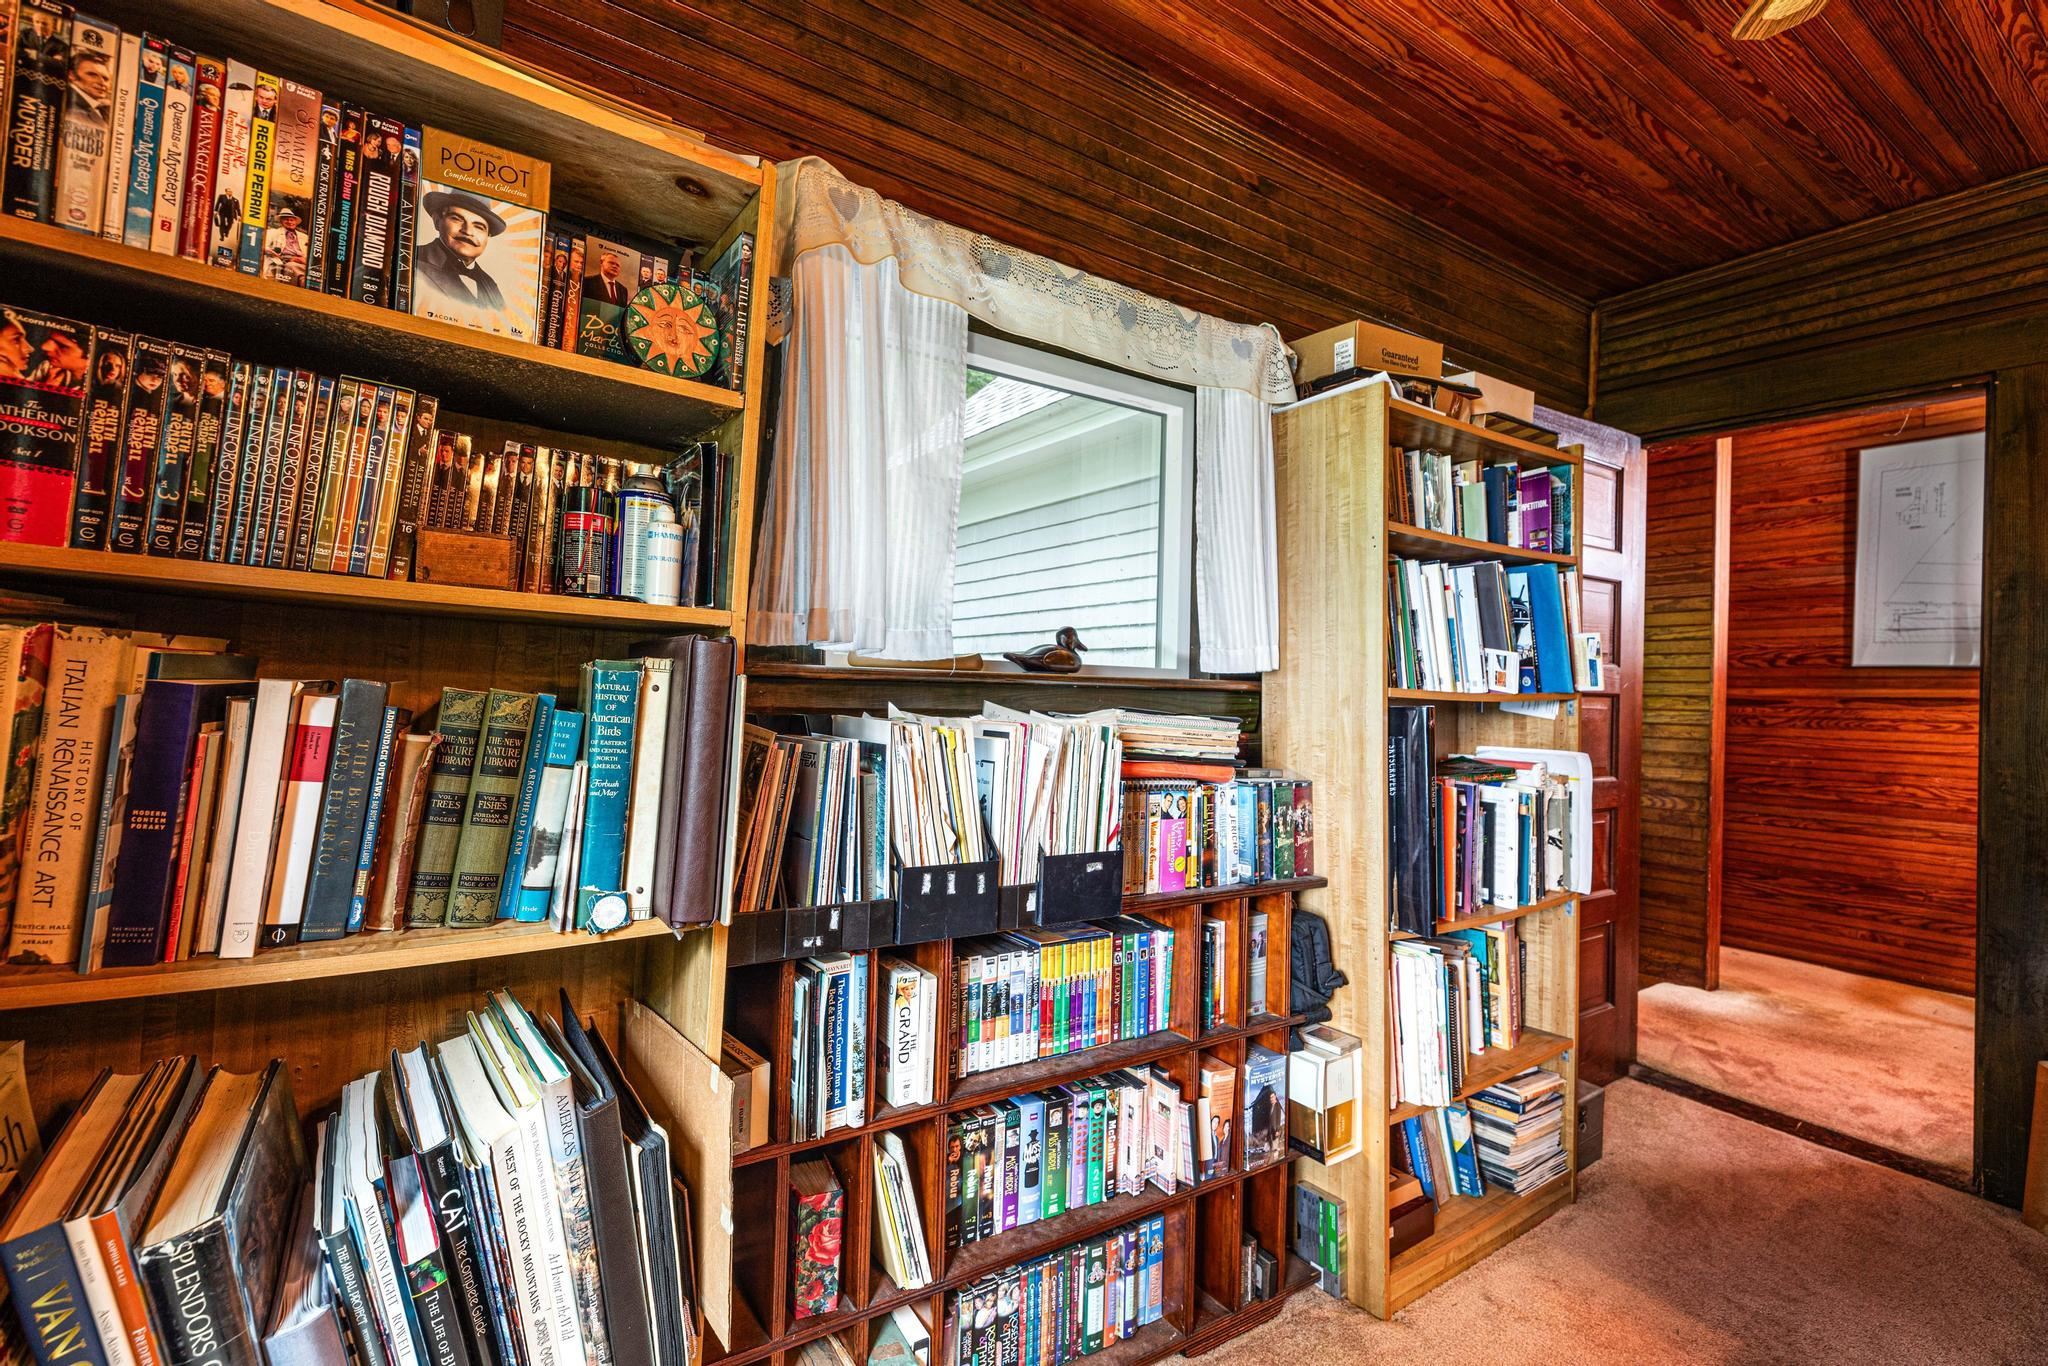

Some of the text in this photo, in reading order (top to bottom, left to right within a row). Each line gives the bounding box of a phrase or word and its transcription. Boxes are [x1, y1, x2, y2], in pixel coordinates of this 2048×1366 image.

[117, 90, 129, 129] DOWNTON
[10, 94, 37, 168] MURDER
[134, 97, 159, 194] Queens Mystery
[195, 110, 215, 174] KAVANAGH
[222, 109, 238, 175] Reginald Perrin
[162, 101, 186, 207] Queens Mystery
[345, 150, 355, 172] MRS
[441, 147, 530, 188] POIROT
[248, 124, 269, 220] REGGIE PERRIN
[444, 168, 528, 198] Complete Cases Collection
[162, 221, 169, 230] 2
[313, 163, 330, 258] DICK FRANCIS MYSTERIES
[362, 171, 392, 270] ROUGH DIAMOND
[247, 233, 257, 247] 1
[398, 198, 414, 272] ANNIKA
[738, 276, 749, 307] STILL
[16, 315, 76, 334] Acorn Media
[736, 312, 748, 337] LIFE
[1381, 348, 1419, 364] Guaranteed
[105, 407, 119, 442] RUTH
[144, 416, 158, 449] RUTH
[180, 420, 194, 454] RUTH
[209, 419, 219, 444] RUTH
[214, 416, 241, 513] UNFORGOTTEN
[237, 418, 262, 514] UNFORGOTTEN
[257, 420, 282, 516] UNFORGOTTEN
[329, 429, 346, 476] Cadfael
[348, 432, 365, 478] Cadfael
[365, 435, 383, 480] Cadfael
[278, 422, 304, 518] UNFORGOTTEN
[404, 461, 416, 507] MYSTERIES
[412, 466, 424, 506] MURDOCH
[121, 485, 145, 499] 2
[157, 490, 180, 501] 3
[189, 487, 205, 497] 4
[402, 525, 413, 533] 16
[594, 683, 632, 692] NATURAL
[594, 693, 630, 703] HISTORY
[551, 719, 577, 729] WATER
[591, 713, 631, 724] American
[605, 703, 617, 711] OF
[553, 731, 571, 739] OVER
[597, 725, 622, 737] Birds
[329, 719, 356, 785] JAMES
[351, 739, 371, 778] THE
[372, 709, 396, 800] ADIRONDACK OUTLAWS:
[436, 756, 472, 767] LIBRARY
[438, 746, 474, 756] NATURE
[483, 757, 519, 768] LIBRARY
[486, 746, 521, 758] NATURE
[549, 752, 567, 760] DAM
[31, 659, 88, 909] ITALIAN RENAISSANCE ART
[68, 740, 94, 832] HISTORY OF
[590, 779, 619, 788] Forbush
[600, 789, 619, 797] May
[431, 799, 461, 809] TREES
[478, 800, 508, 810] FISHES
[513, 767, 536, 856] ARROWHEAD FARM
[1229, 814, 1239, 855] JERICHO
[521, 905, 538, 913] Hyde
[20, 938, 54, 946] ABRAMS
[48, 923, 73, 931] HALL
[830, 1005, 835, 1013] &
[836, 995, 844, 1037] American
[898, 1006, 911, 1064] GRAND
[835, 1035, 843, 1073] Country
[504, 1145, 518, 1174] WEST
[1108, 1120, 1116, 1173] McCallum
[509, 1174, 520, 1190] OF
[950, 1168, 960, 1199] Rebus
[966, 1169, 976, 1199] Rebus
[1093, 1169, 1099, 1181] 2
[439, 1189, 472, 1234] CAT
[511, 1193, 524, 1218] THE
[516, 1215, 532, 1253] ROCKY
[335, 1244, 349, 1261] THE
[340, 1258, 358, 1294] MURAL
[363, 1204, 389, 1271] MOUNTAIN
[380, 1270, 399, 1312] LIGHT
[391, 1311, 412, 1358] ROWELL
[455, 1236, 487, 1336] The Complete Guide
[521, 1251, 542, 1315] MOUNTAINS
[169, 1240, 218, 1357] SPLENDORS
[349, 1289, 368, 1325] PROJECT
[31, 1279, 87, 1361] VAN
[425, 1291, 449, 1344] THE LIFE
